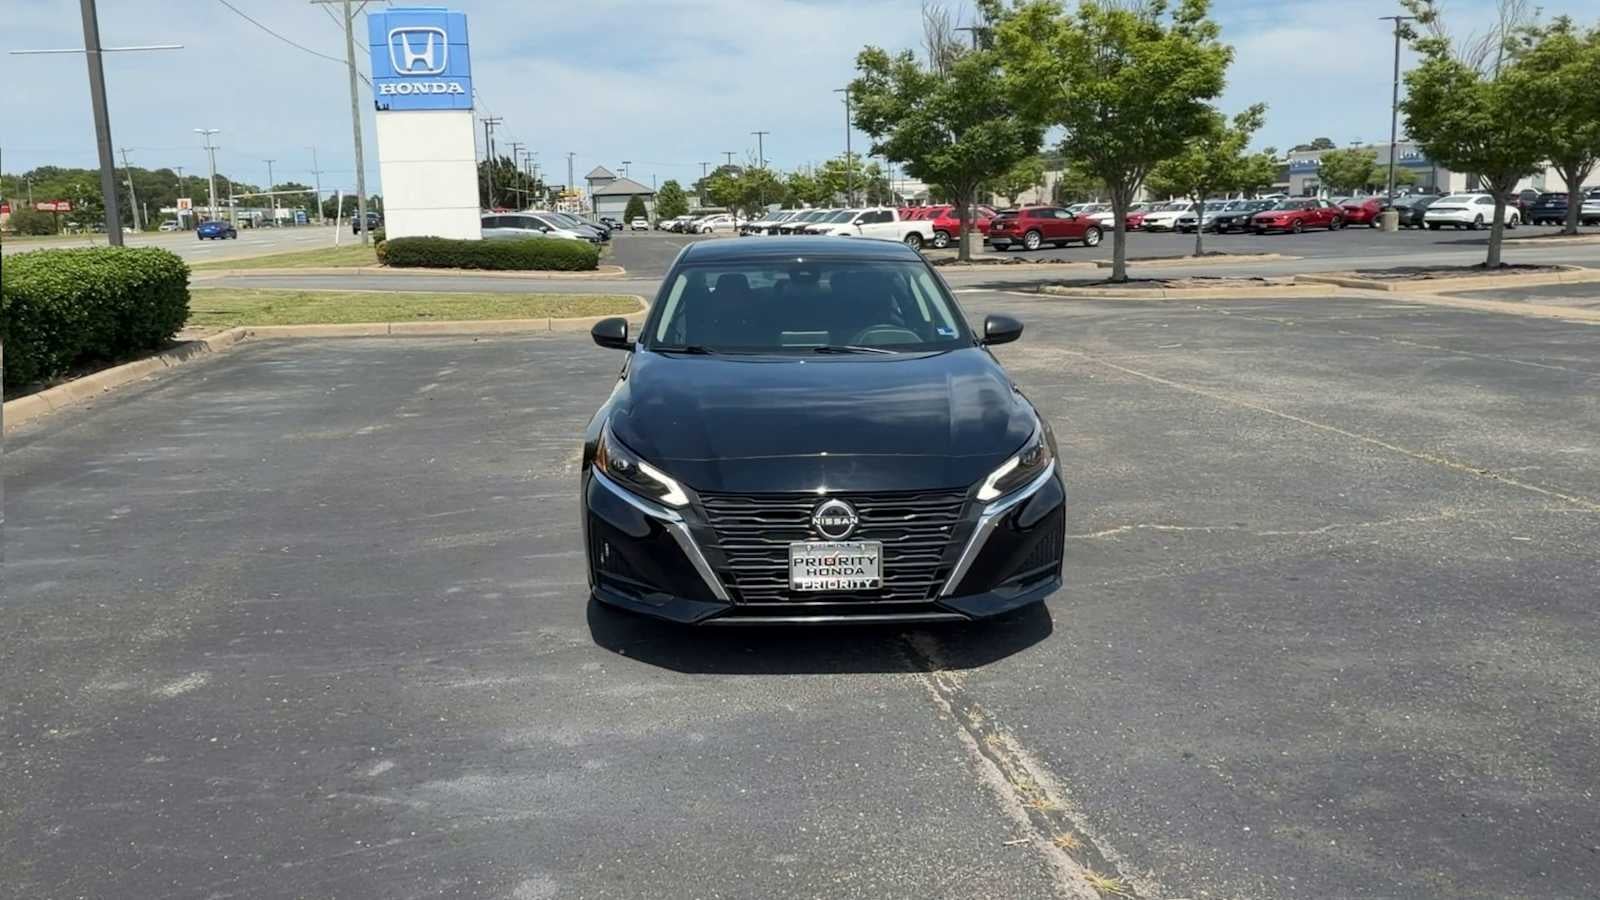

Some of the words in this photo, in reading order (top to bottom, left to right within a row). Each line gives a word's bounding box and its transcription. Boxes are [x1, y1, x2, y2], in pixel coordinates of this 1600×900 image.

[379, 82, 464, 95] HONDA
[812, 515, 858, 525] NISSAN
[793, 556, 876, 566] PRIORITY
[806, 567, 864, 576] HONDA
[802, 580, 872, 589] PRIORITY
